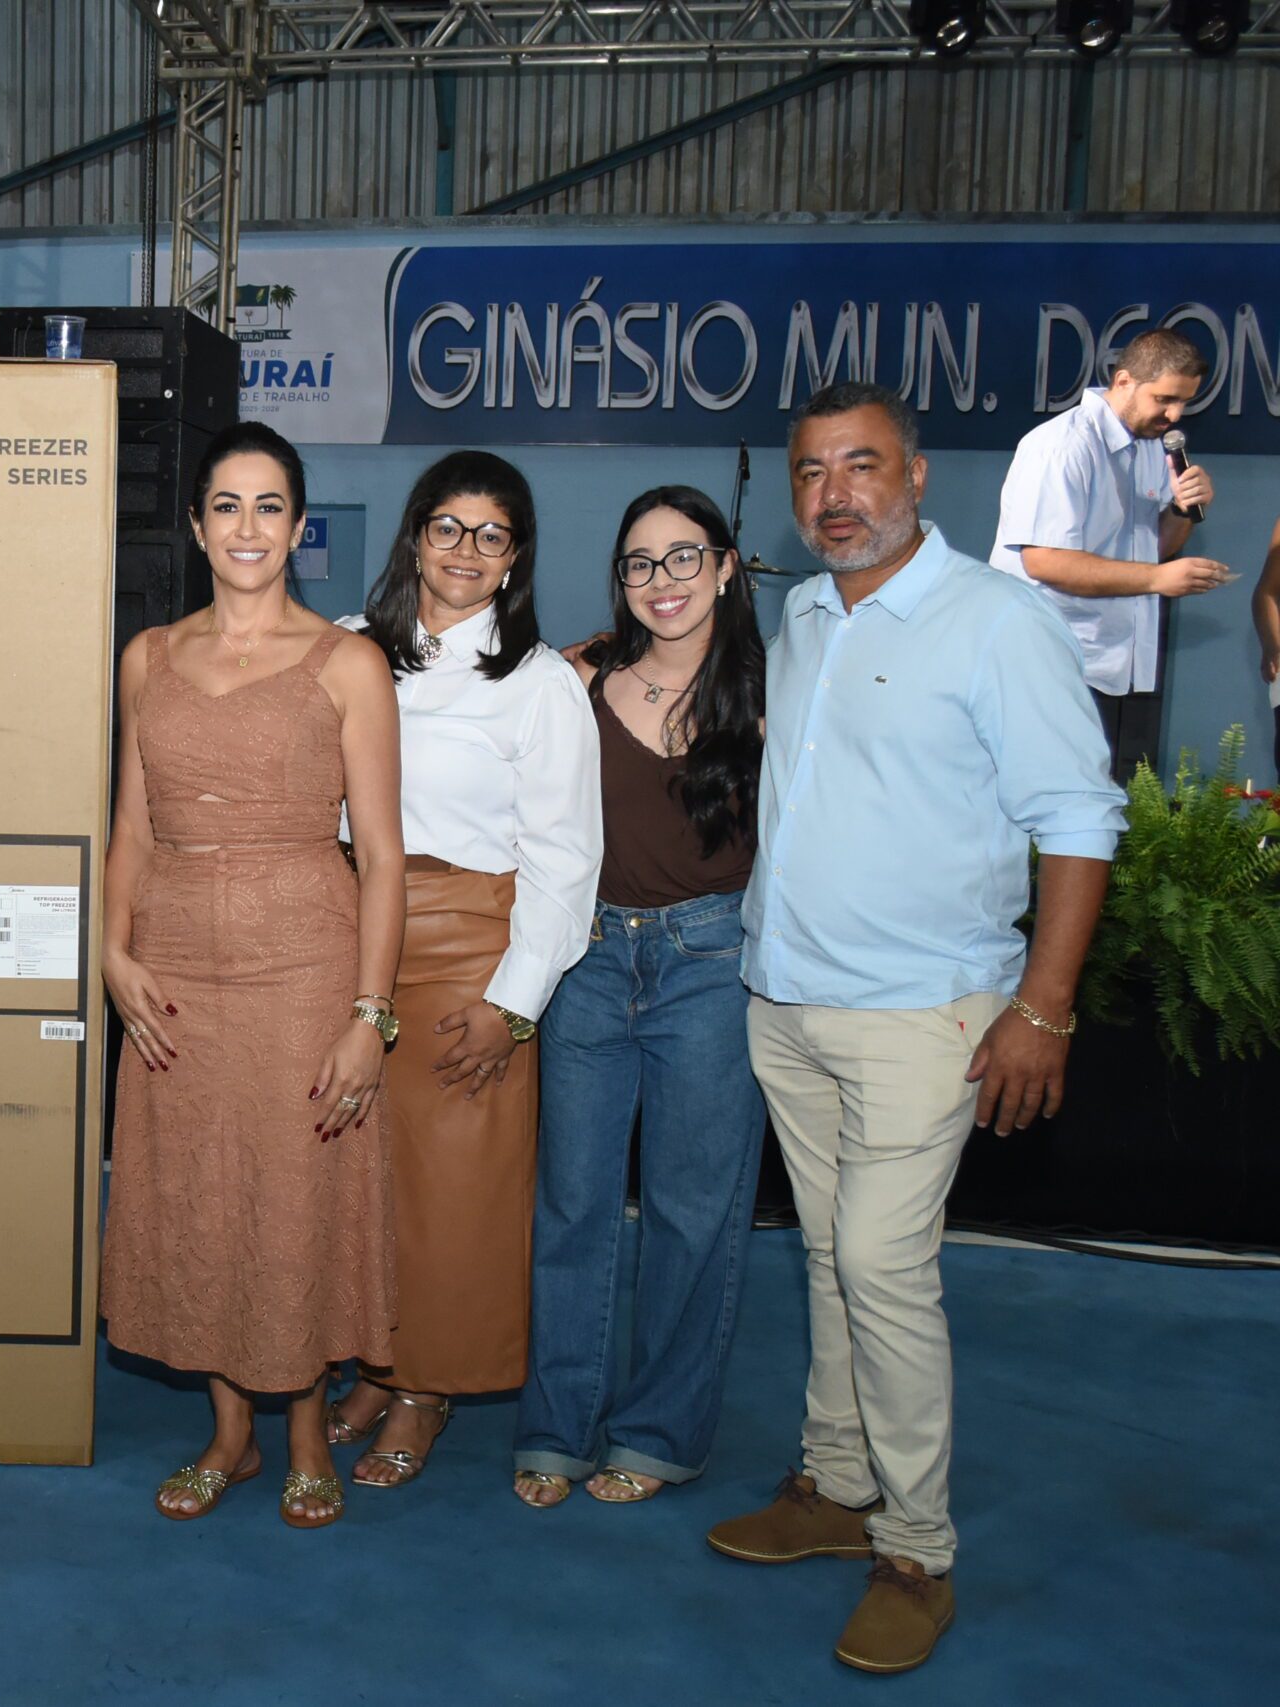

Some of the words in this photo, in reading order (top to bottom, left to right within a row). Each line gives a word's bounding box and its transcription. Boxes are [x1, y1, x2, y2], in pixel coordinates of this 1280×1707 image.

[407, 275, 759, 411] GINÁSIO
[777, 299, 999, 413] MUN.
[270, 349, 282, 358] DE
[252, 391, 260, 402] E
[264, 391, 330, 402] TRABALHO
[7, 467, 88, 486] SERIES
